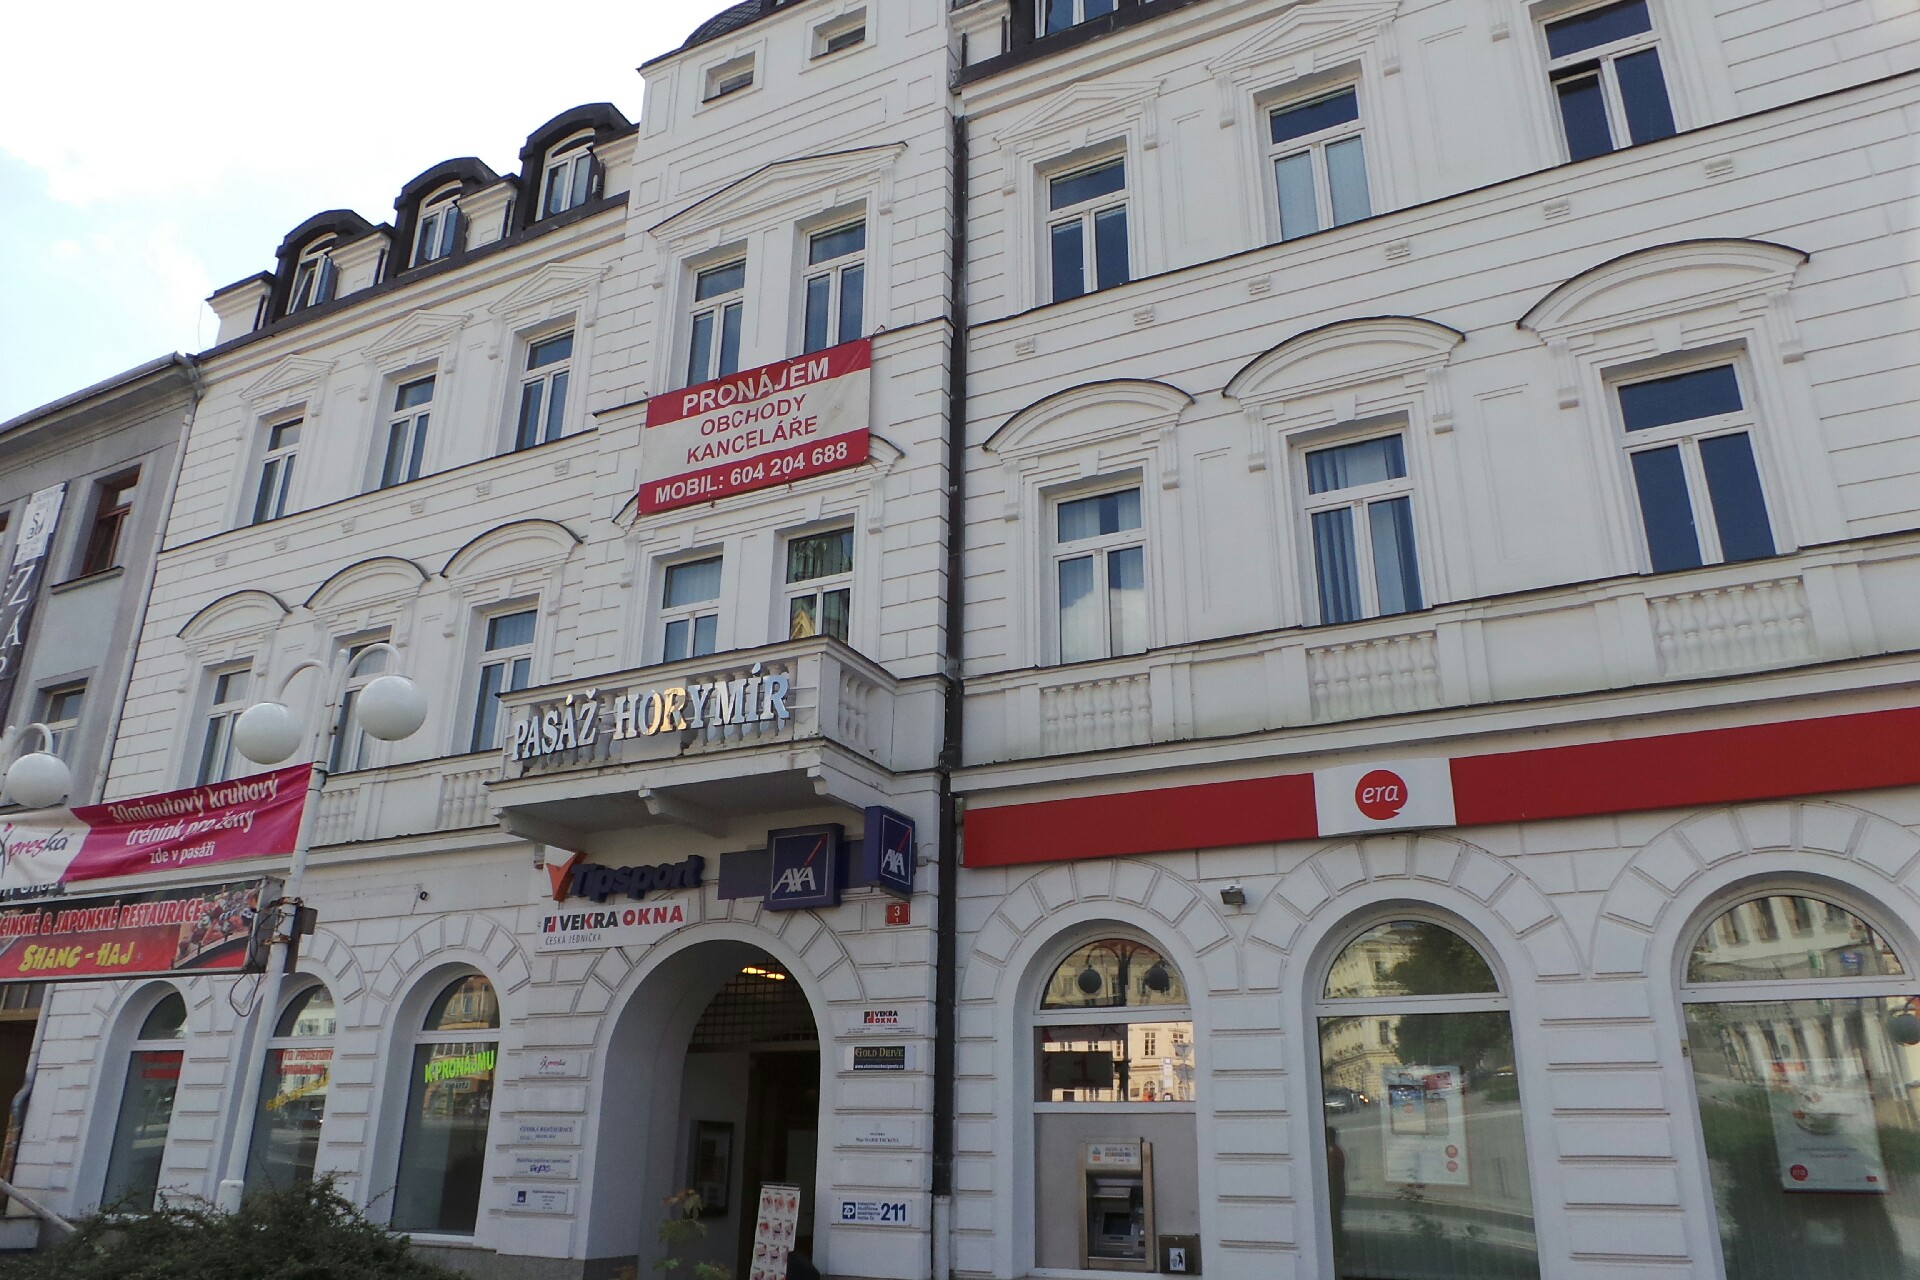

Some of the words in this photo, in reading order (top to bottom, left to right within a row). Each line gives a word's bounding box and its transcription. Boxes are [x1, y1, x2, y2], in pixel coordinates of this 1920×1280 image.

[682, 357, 829, 417] PRONÁJEM
[701, 394, 807, 436] OBCHODY
[686, 415, 818, 464] KANCELÁŘE
[655, 473, 724, 504] MOBIL:
[730, 463, 765, 487] 604
[770, 452, 805, 477] 204
[812, 441, 848, 466] 688
[511, 688, 598, 761] PASÁŽ
[613, 663, 790, 740] HORYMÍR
[108, 789, 205, 823] 30minutový
[206, 773, 279, 808] kruhový
[1362, 785, 1399, 804] era
[125, 819, 187, 846] trénink
[180, 818, 216, 841] pro
[150, 847, 169, 864] zde
[172, 851, 179, 861] v
[179, 841, 216, 865] pasáži
[881, 848, 906, 877] AXA
[569, 855, 704, 903] Tipsport
[772, 866, 816, 894] AXA
[41, 911, 53, 936] &
[53, 900, 120, 934] JAPONSKÉ
[118, 897, 203, 930] RESTAURACE
[559, 911, 619, 932] VEKRA
[622, 905, 684, 927] OKNA
[894, 905, 901, 917] 3
[569, 932, 602, 944] JEDNIČKA
[96, 942, 135, 967] HAJ
[424, 1064, 433, 1084] K
[435, 1050, 495, 1080] PRONÁJMU
[880, 1202, 906, 1222] 211
